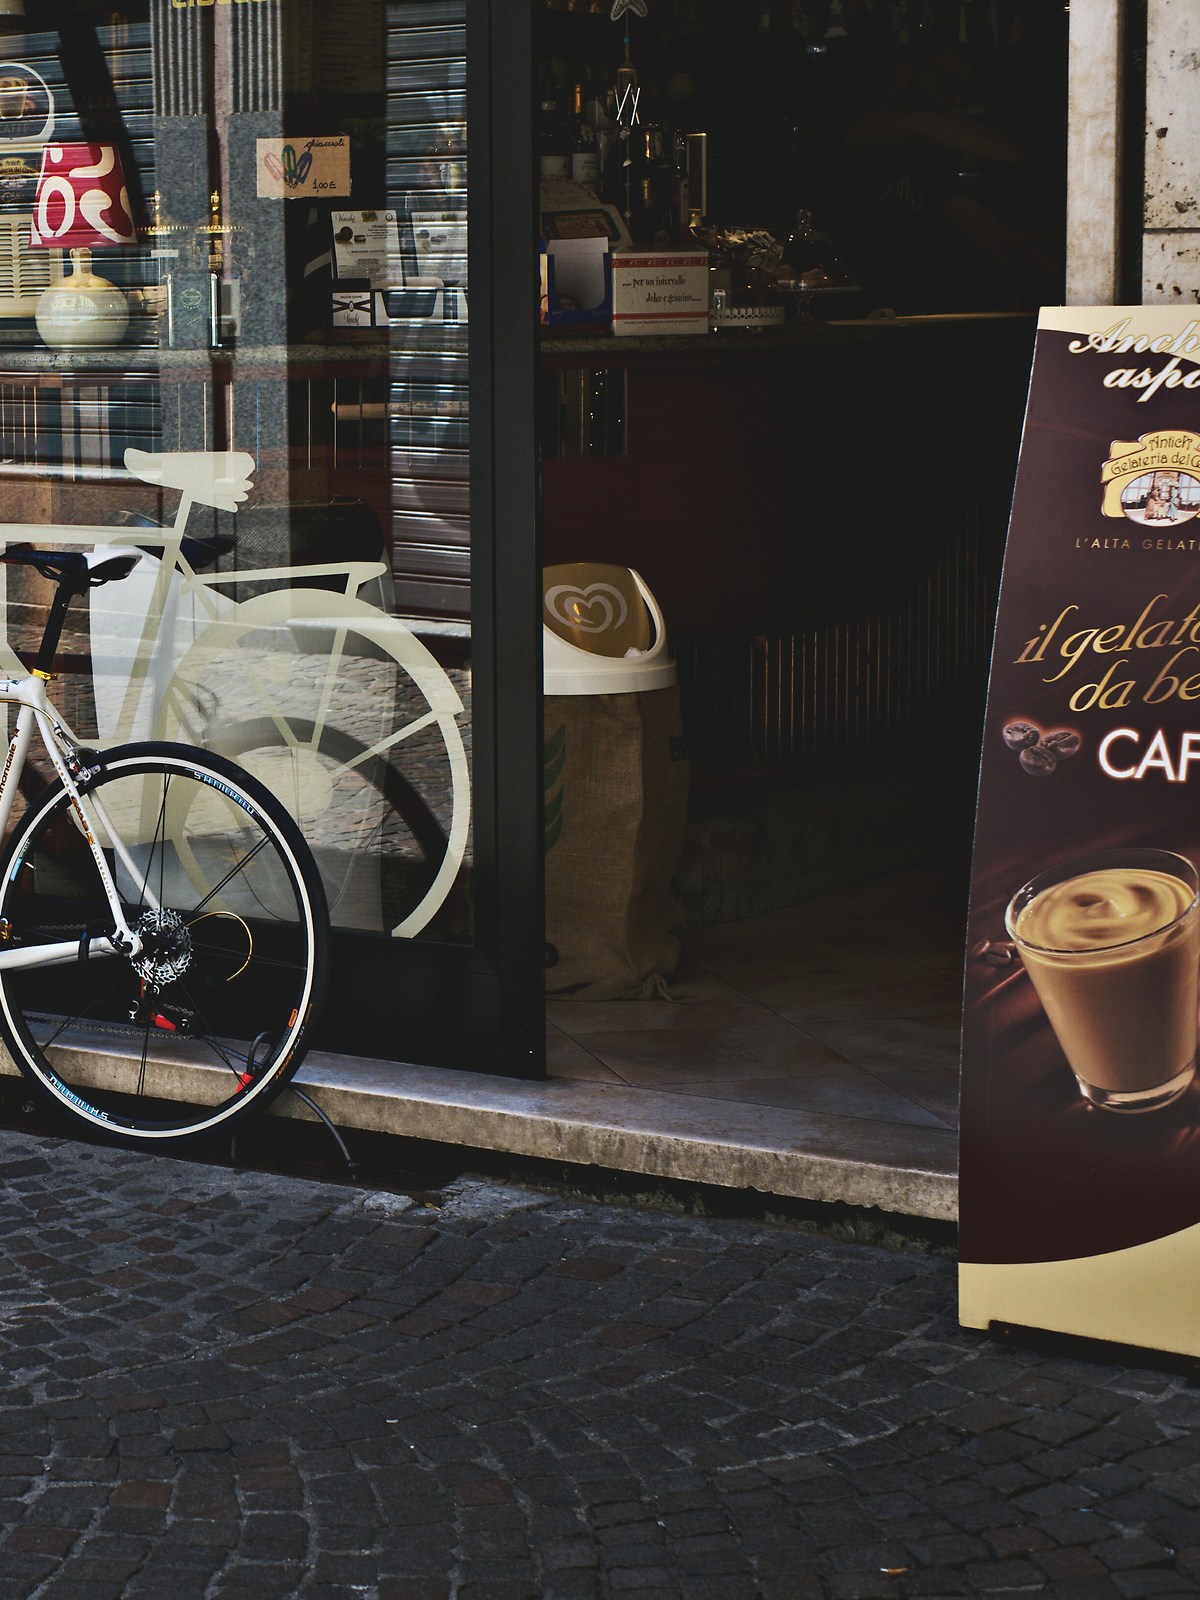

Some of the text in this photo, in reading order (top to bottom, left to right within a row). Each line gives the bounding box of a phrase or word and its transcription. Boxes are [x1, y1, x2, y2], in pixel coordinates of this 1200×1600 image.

[1111, 453, 1168, 475] Gelateria
[1171, 452, 1191, 466] del
[1075, 538, 1200, 551] L'ALTA GELAT
[1013, 605, 1079, 664] il
[1069, 659, 1137, 712] da
